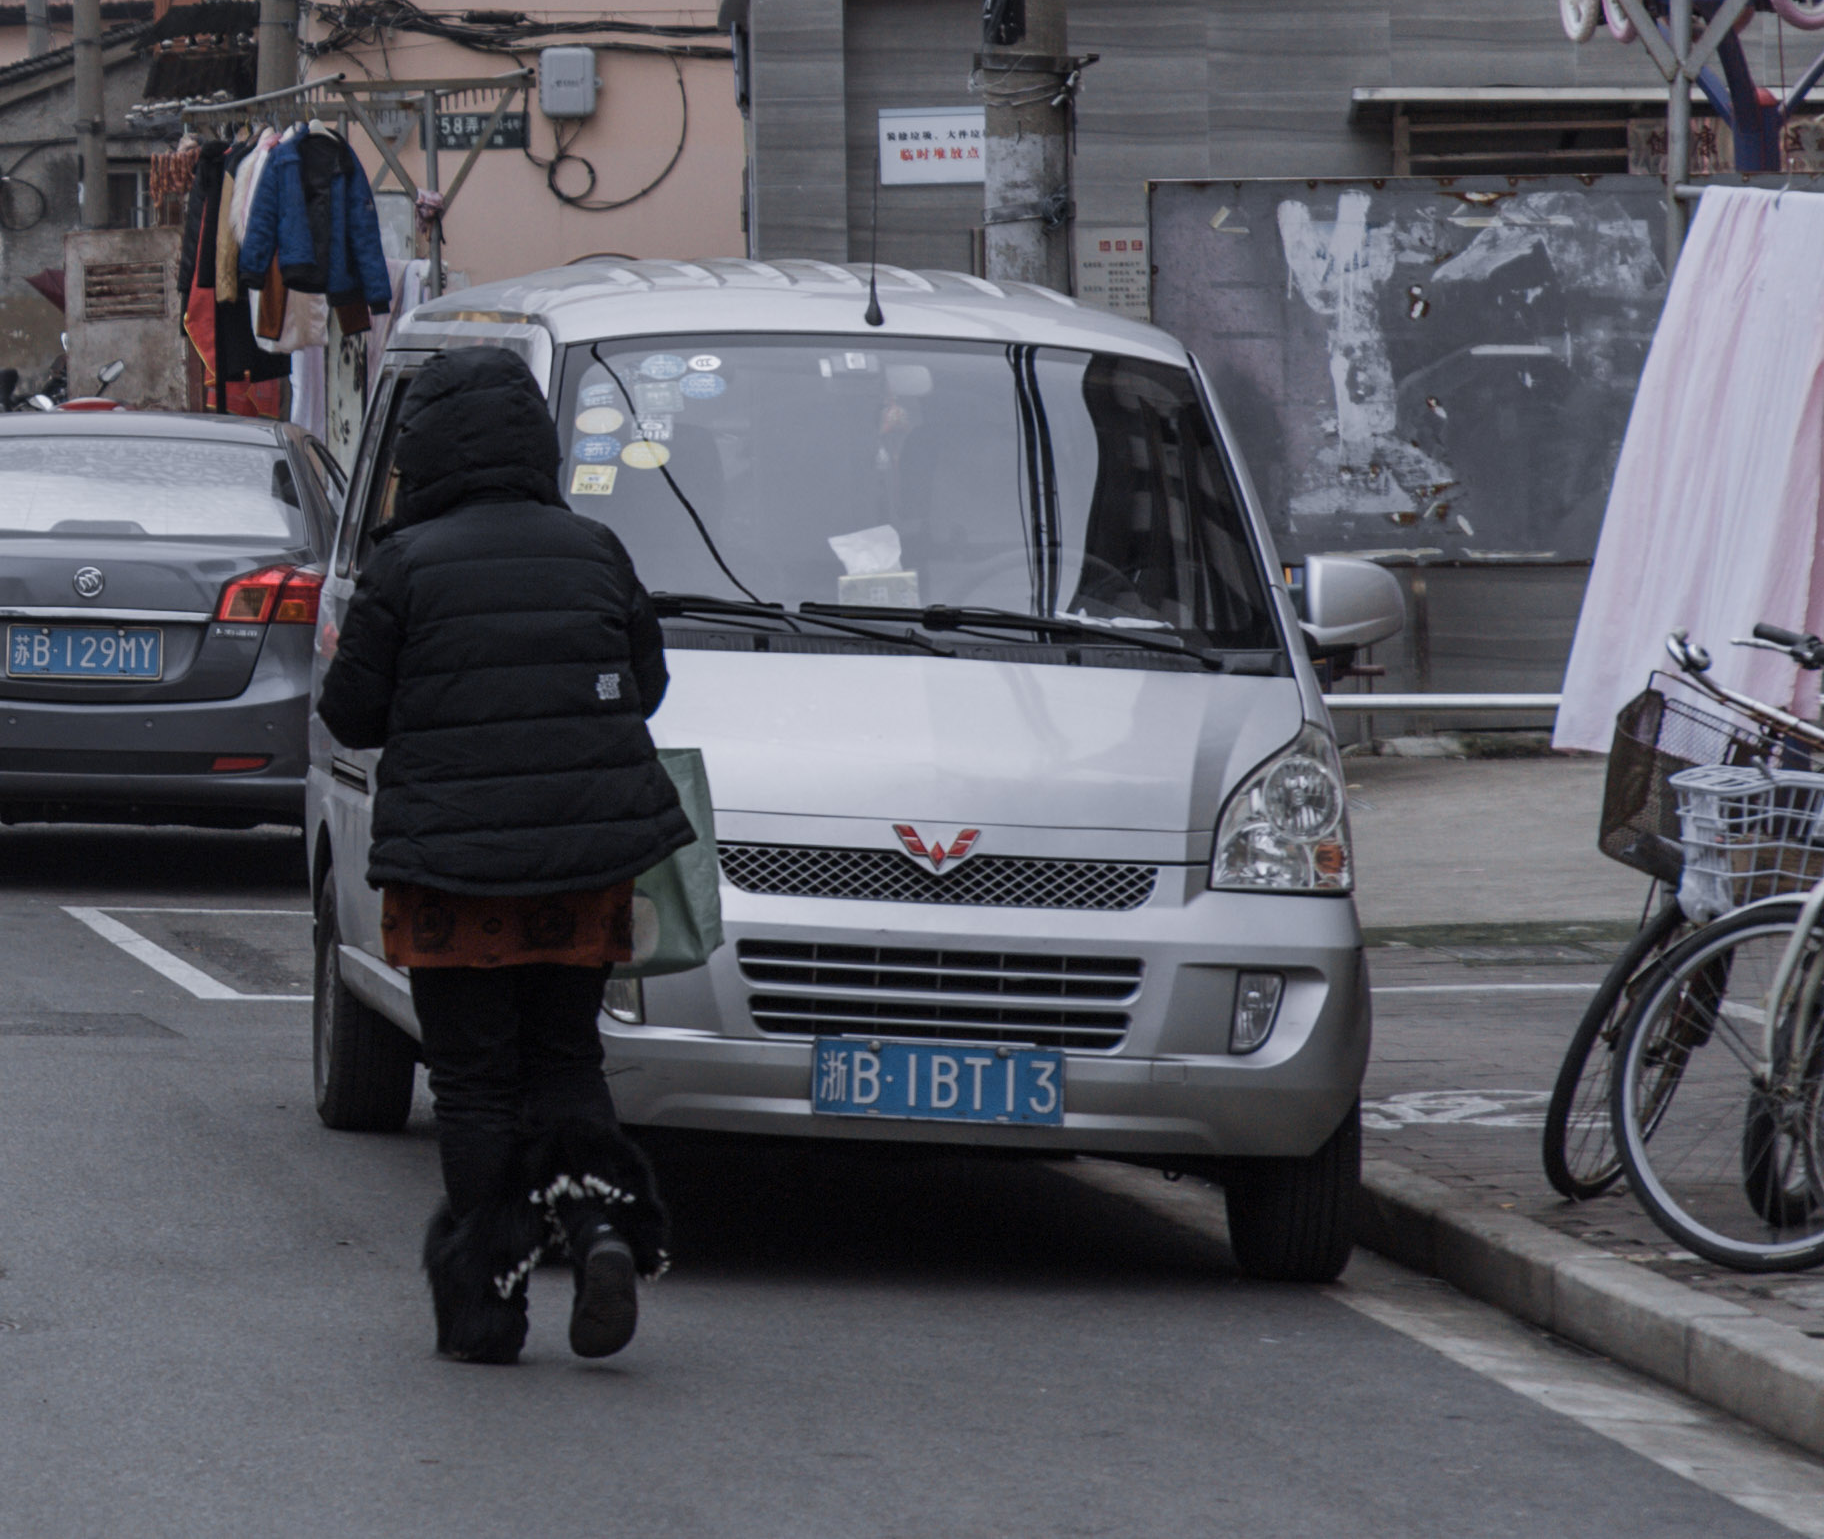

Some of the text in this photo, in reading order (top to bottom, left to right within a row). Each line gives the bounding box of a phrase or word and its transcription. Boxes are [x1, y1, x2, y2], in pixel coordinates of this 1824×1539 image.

[435, 116, 479, 135] 58弄
[886, 129, 986, 142] 装修垃圾、大件垃
[899, 145, 980, 161] 临时堆放点
[14, 635, 155, 669] 苏B·129MY
[820, 1049, 1057, 1114] 浙B·1BT13
